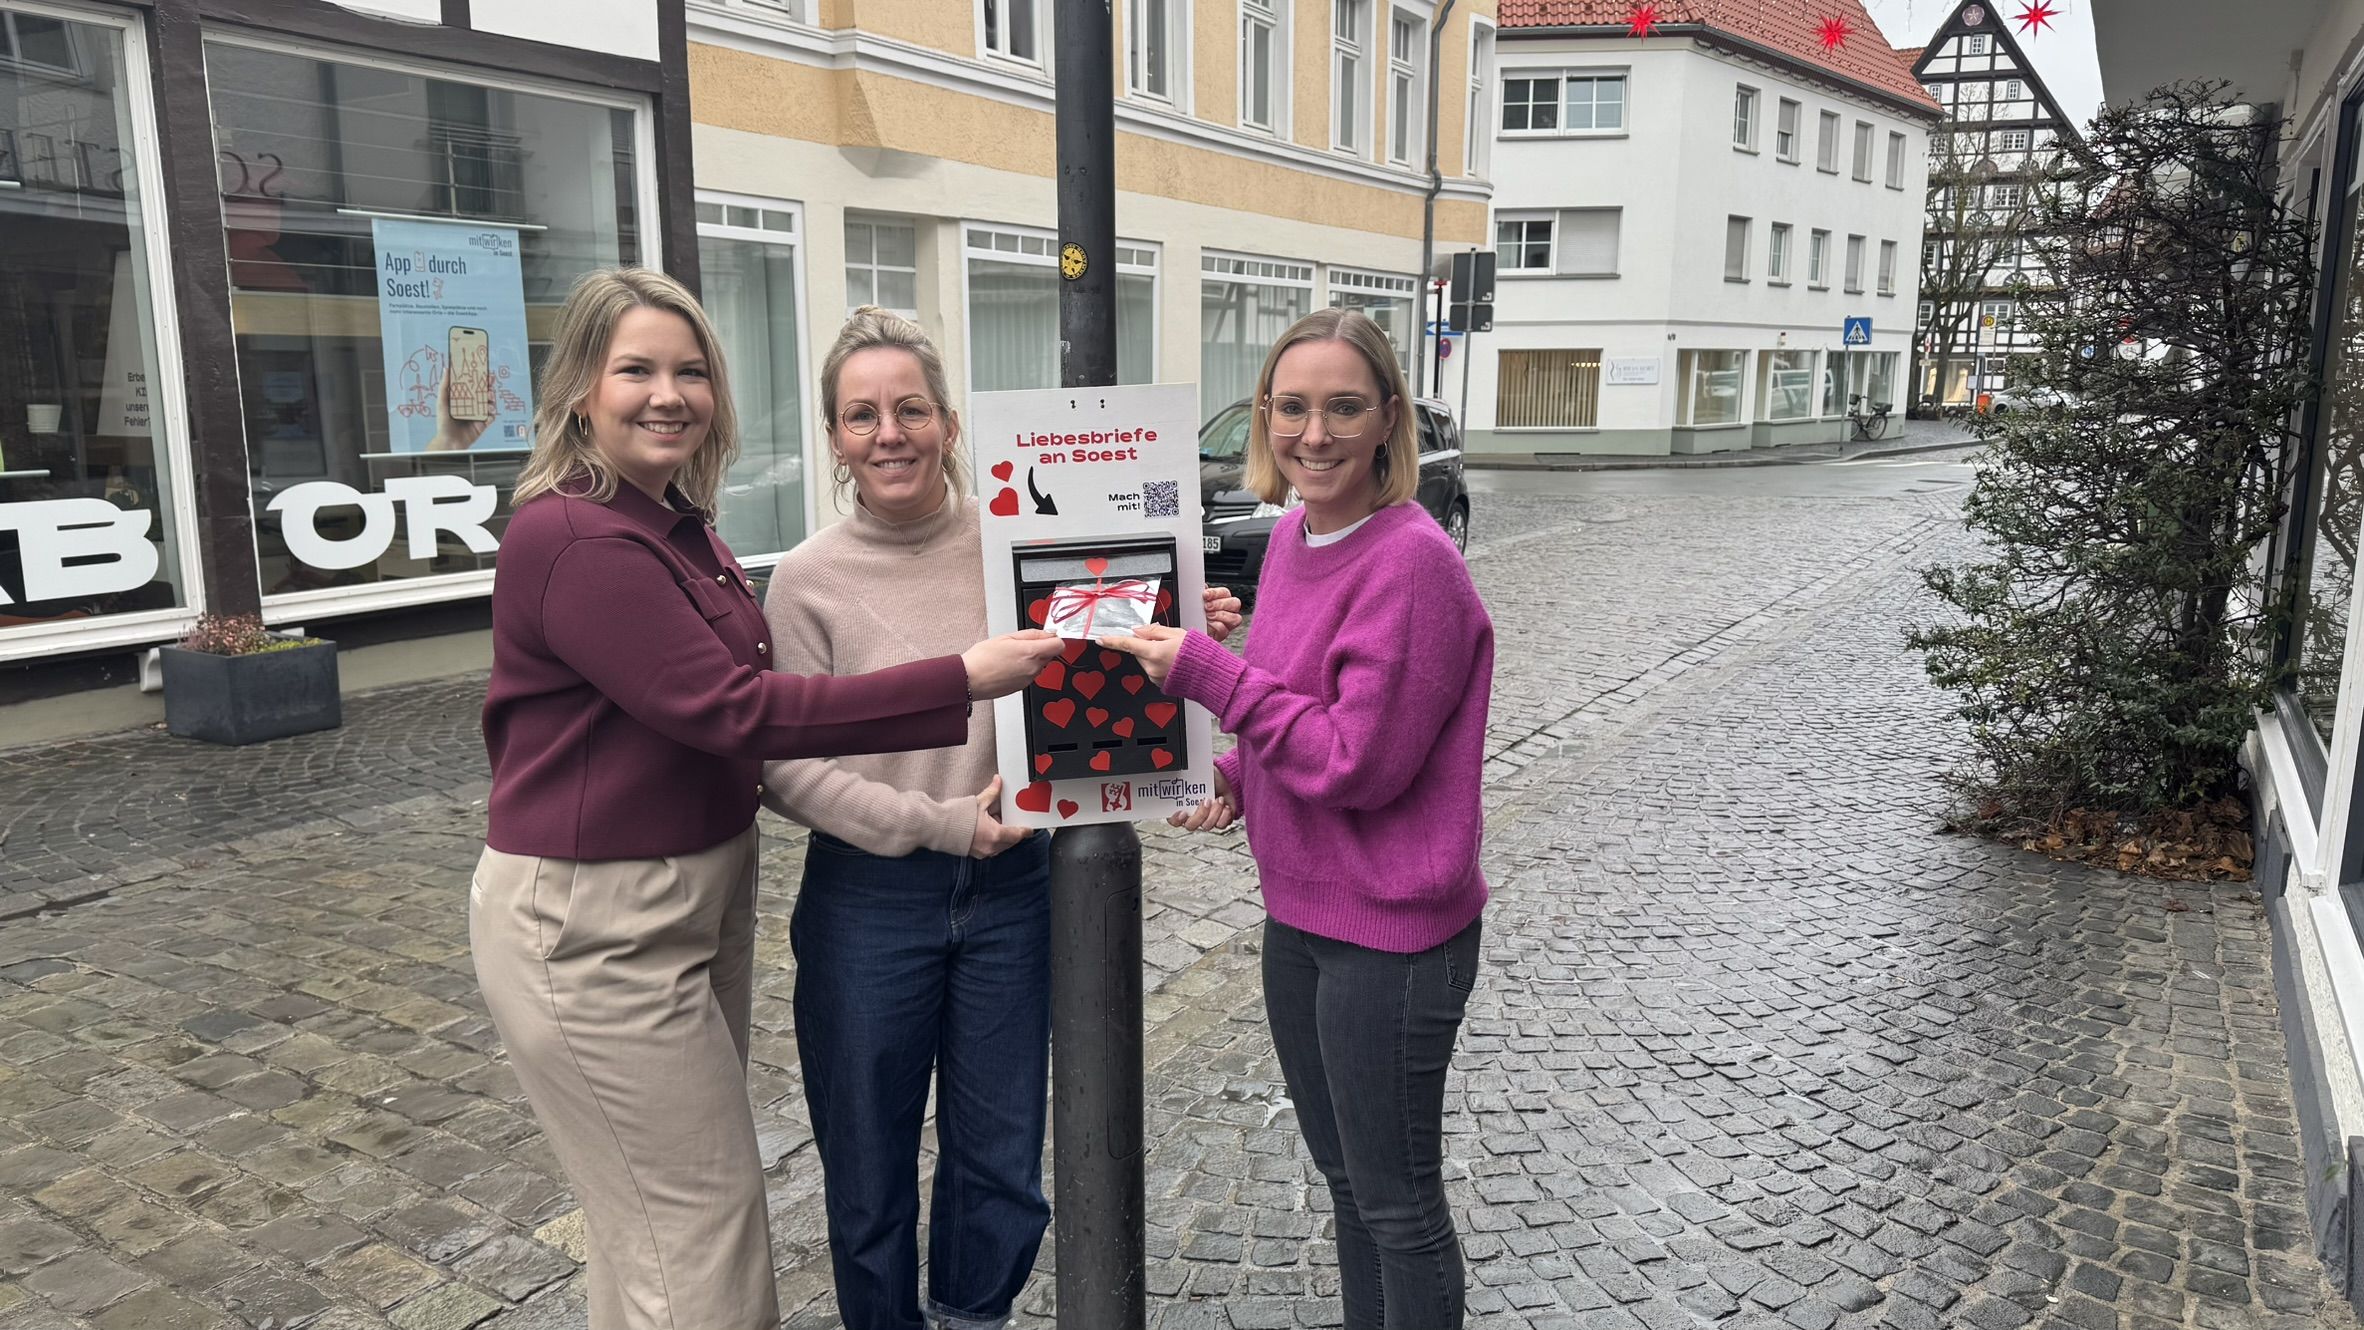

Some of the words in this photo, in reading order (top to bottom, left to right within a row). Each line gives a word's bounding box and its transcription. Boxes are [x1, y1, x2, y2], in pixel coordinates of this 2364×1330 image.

[469, 233, 512, 249] mitwirken
[385, 252, 411, 275] App
[429, 254, 467, 275] durch
[386, 278, 430, 298] Soest!
[1016, 428, 1157, 447] Liebesbriefe
[1039, 452, 1066, 464] an
[1072, 447, 1138, 463] Soest
[1108, 493, 1140, 502] Mach
[1117, 502, 1141, 511] mit!
[1203, 537, 1219, 550] 185
[1138, 778, 1206, 799] mitwirken
[1176, 799, 1183, 807] in
[1185, 797, 1206, 807] Soe
